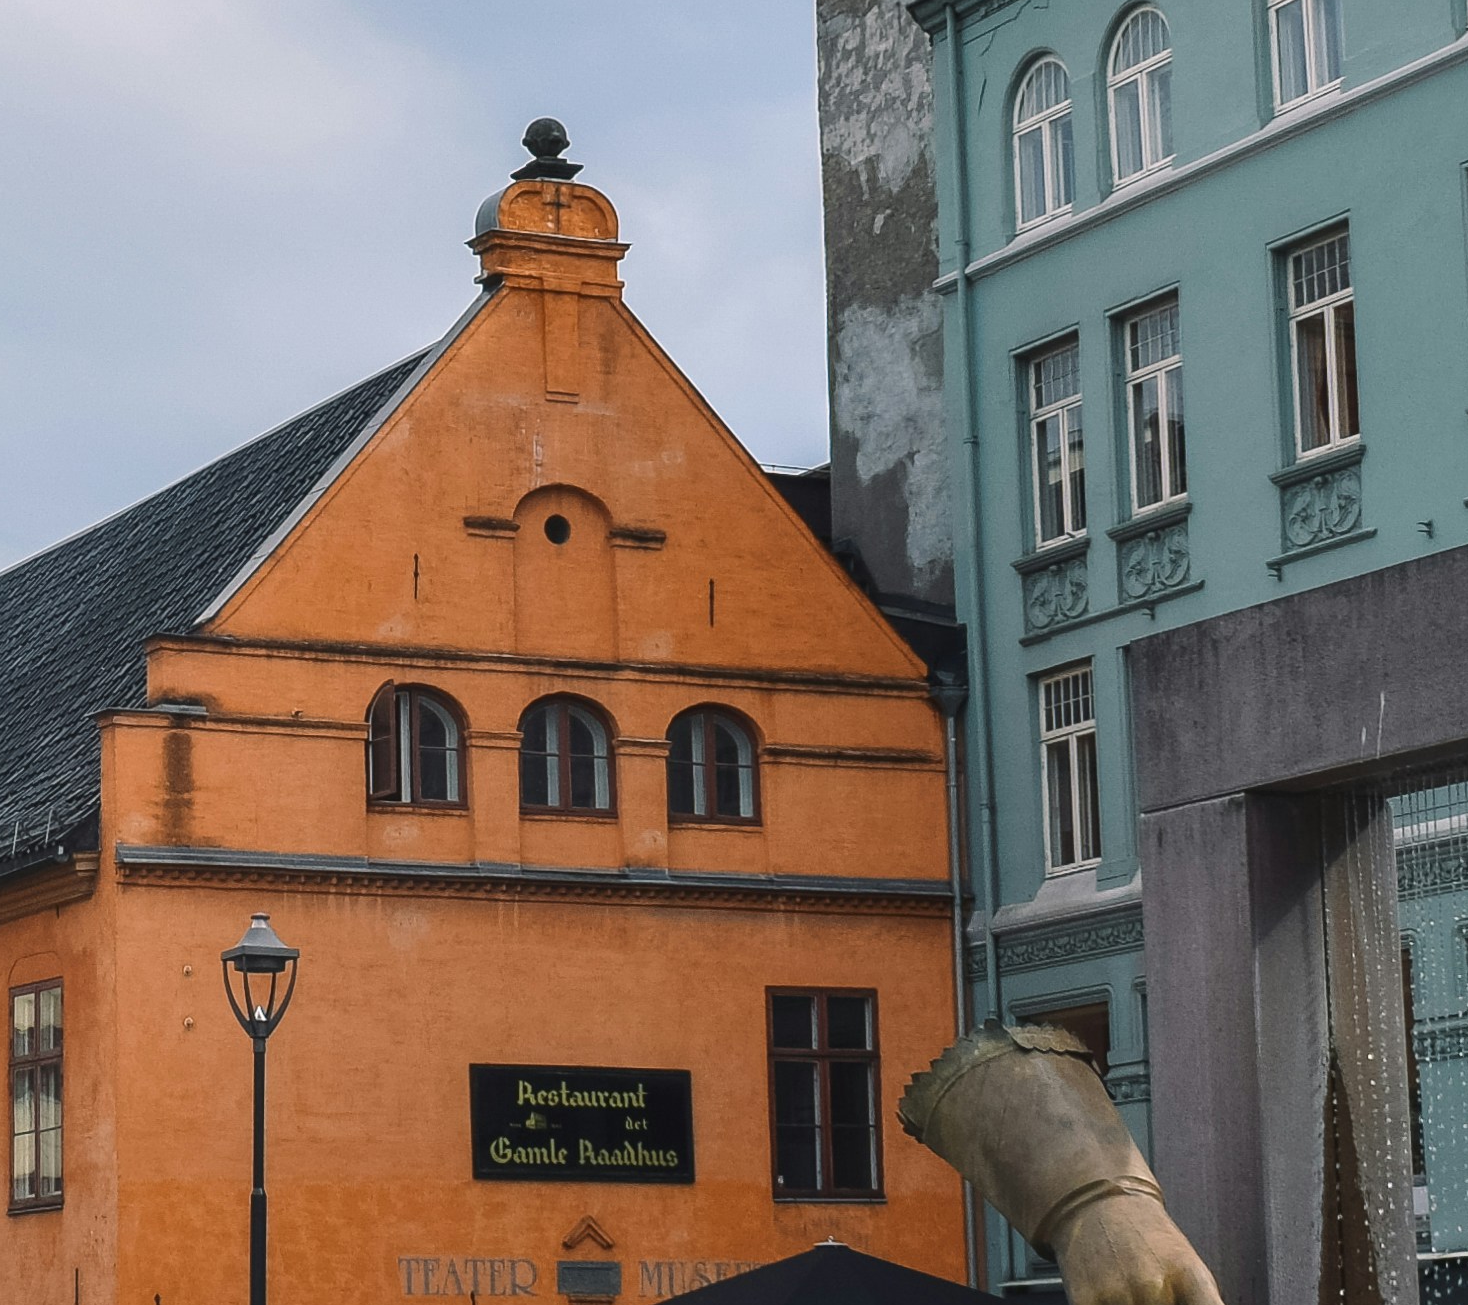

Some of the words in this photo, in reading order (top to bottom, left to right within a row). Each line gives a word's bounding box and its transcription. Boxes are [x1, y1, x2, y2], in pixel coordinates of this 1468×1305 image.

[517, 1080, 648, 1108] Restaurant
[625, 1116, 649, 1131] det
[490, 1137, 568, 1166] Gamle
[578, 1138, 679, 1167] Raadhus
[397, 1255, 538, 1297] TEATER
